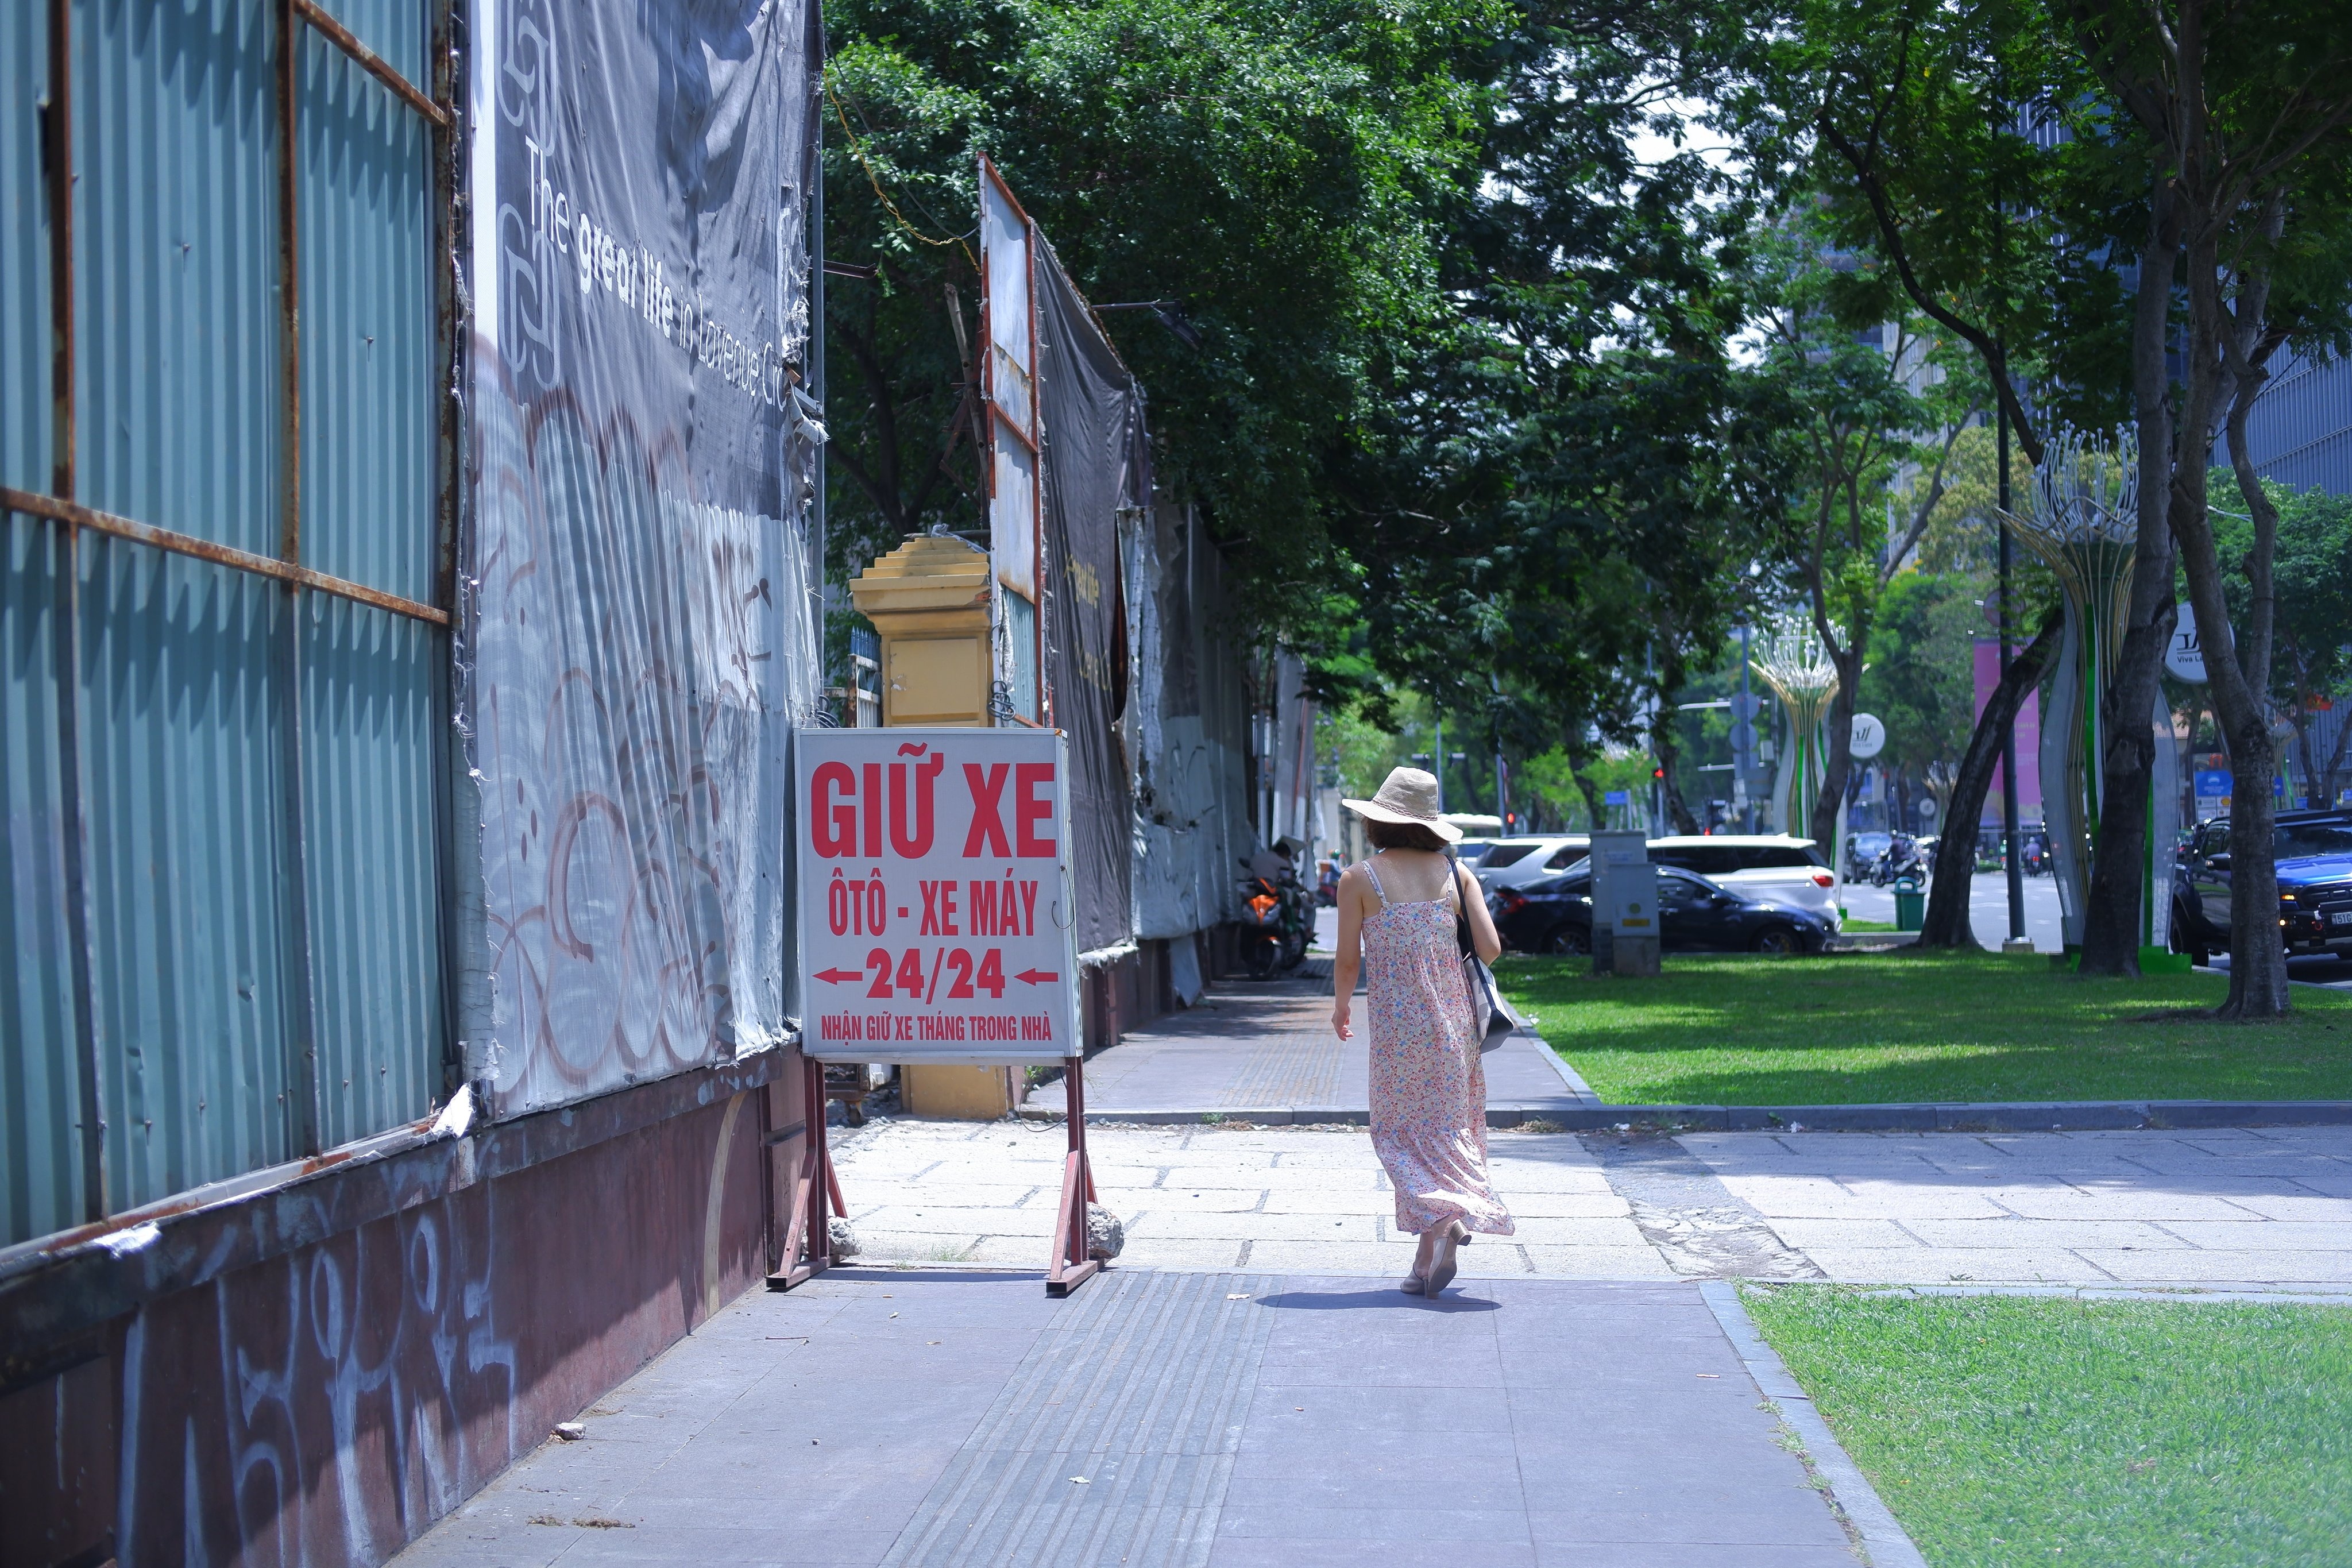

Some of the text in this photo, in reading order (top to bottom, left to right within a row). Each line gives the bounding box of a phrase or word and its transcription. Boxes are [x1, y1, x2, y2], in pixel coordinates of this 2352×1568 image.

[526, 135, 570, 253] The
[578, 213, 638, 309] great
[643, 247, 673, 338] life
[679, 284, 693, 354] in
[698, 293, 759, 396] Lovenue
[2177, 655, 2193, 663] Viva
[812, 742, 1056, 859] GIỮ XE
[828, 867, 886, 936] ÔTÔ
[920, 880, 959, 936] XE
[969, 868, 1038, 936] MÁY
[866, 947, 1006, 1005] 24/24
[821, 1010, 1052, 1046] NHẬN GIỮ XE THÁNG TRONG NHÀ
